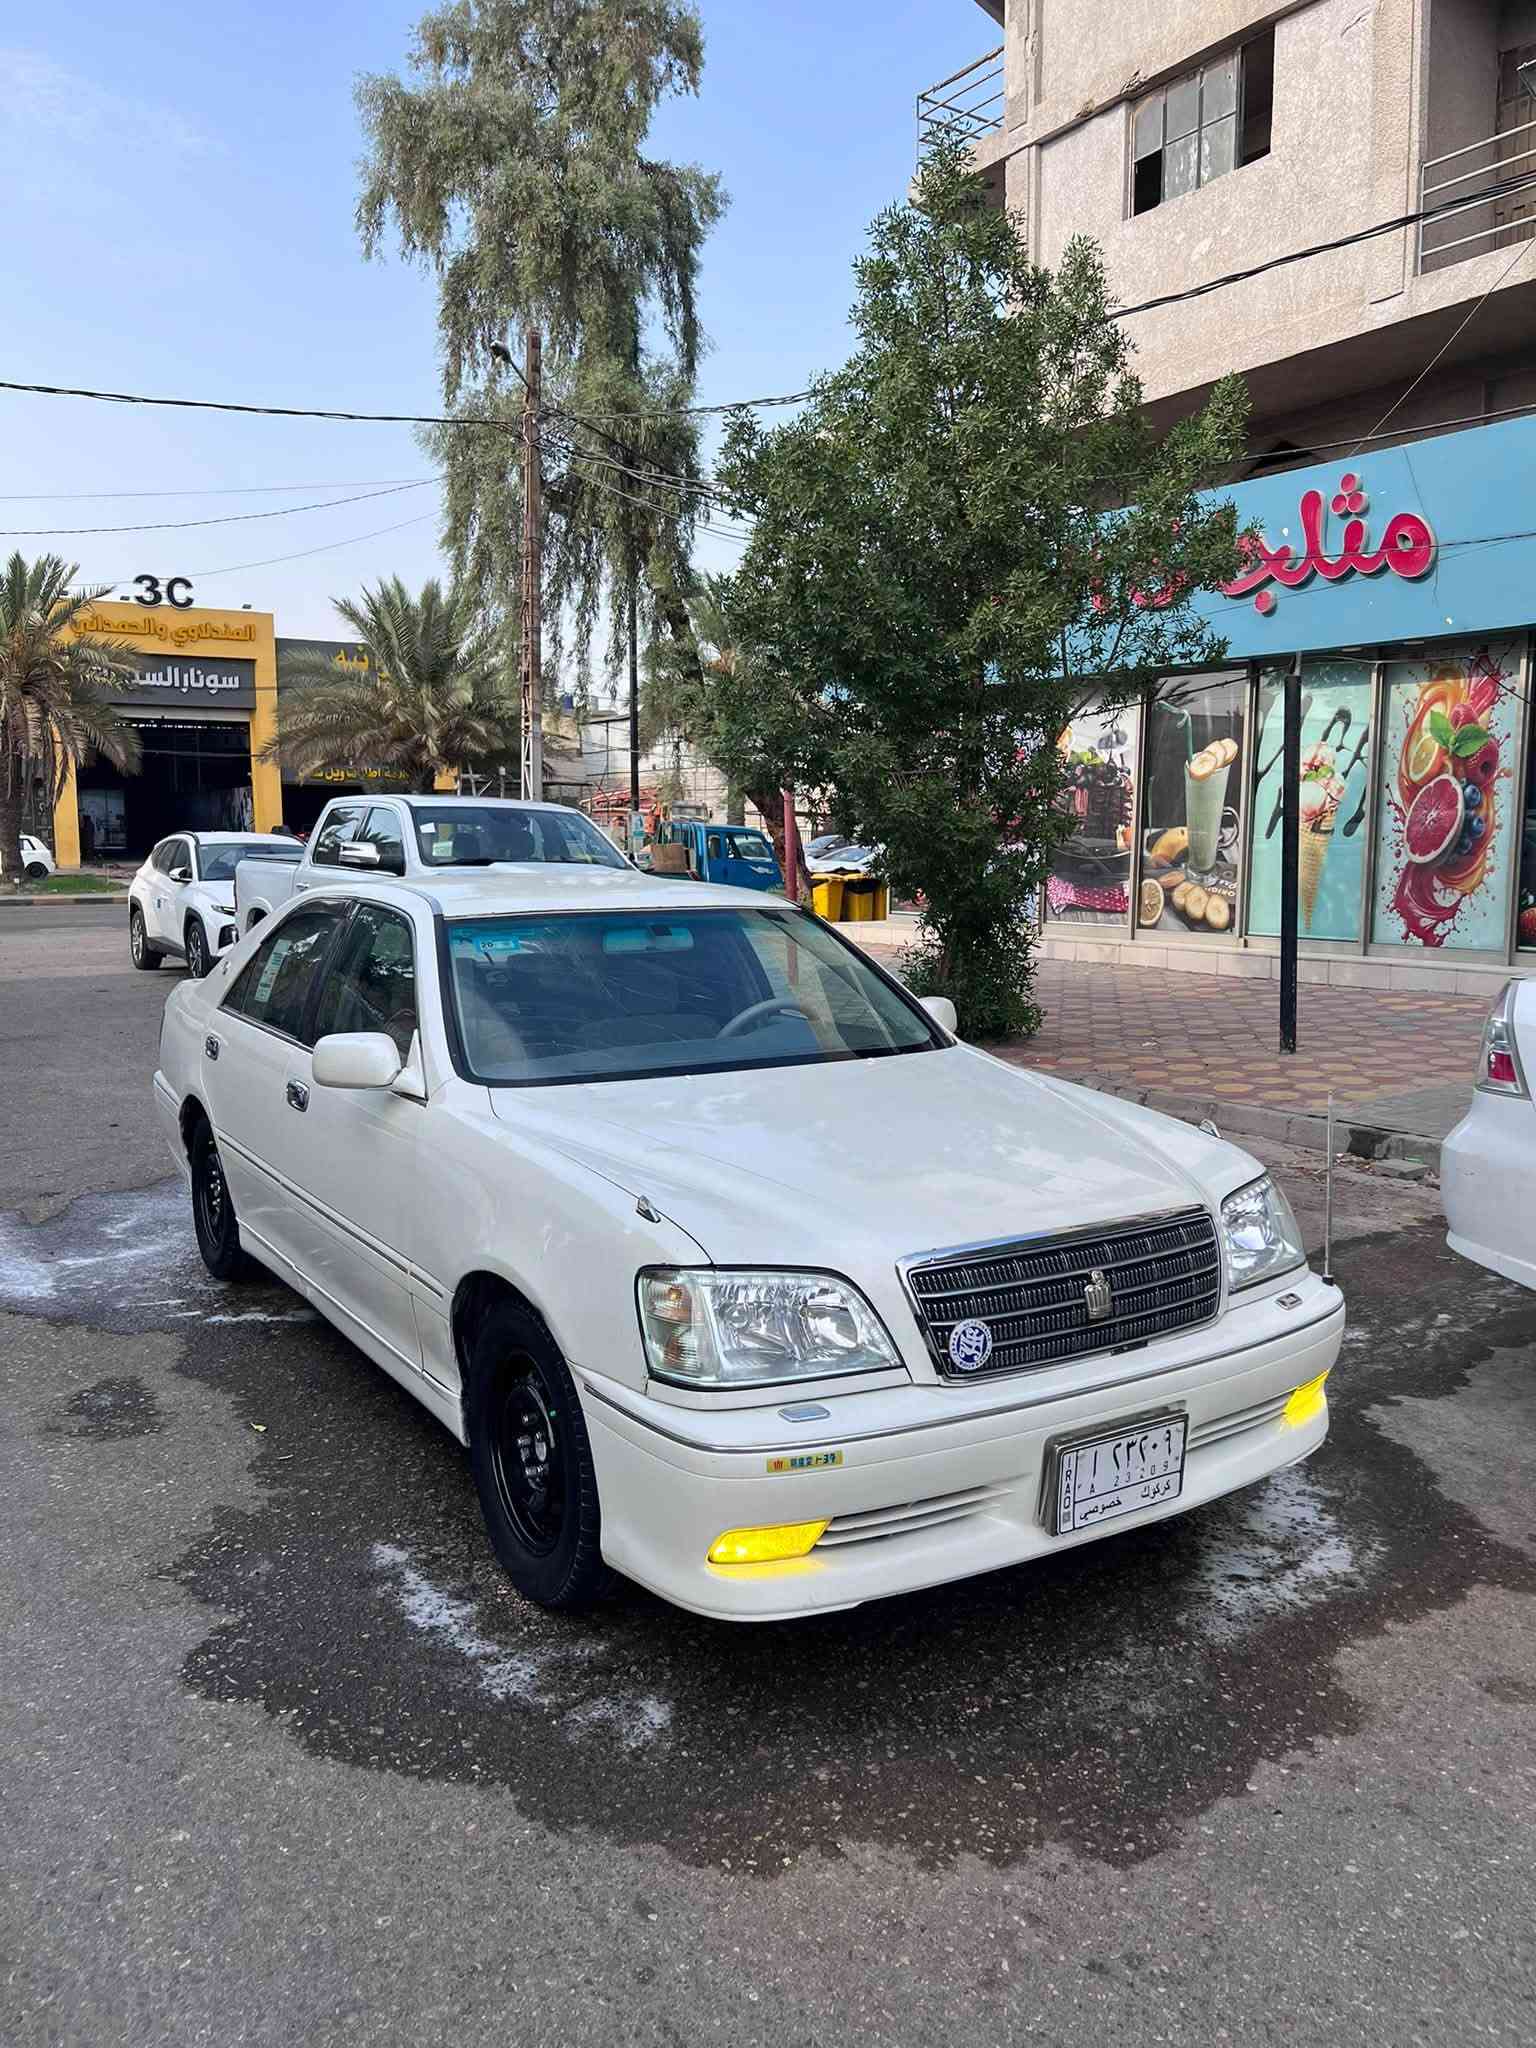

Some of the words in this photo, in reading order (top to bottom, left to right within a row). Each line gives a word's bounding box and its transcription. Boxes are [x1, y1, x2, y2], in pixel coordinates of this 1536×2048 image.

[133, 574, 194, 609] 3C
[182, 668, 240, 695] سونار
[1063, 1455, 1073, 1510] IRAQ
[1140, 1479, 1171, 1499] كركوك
[1079, 1496, 1122, 1520] خصوصي
